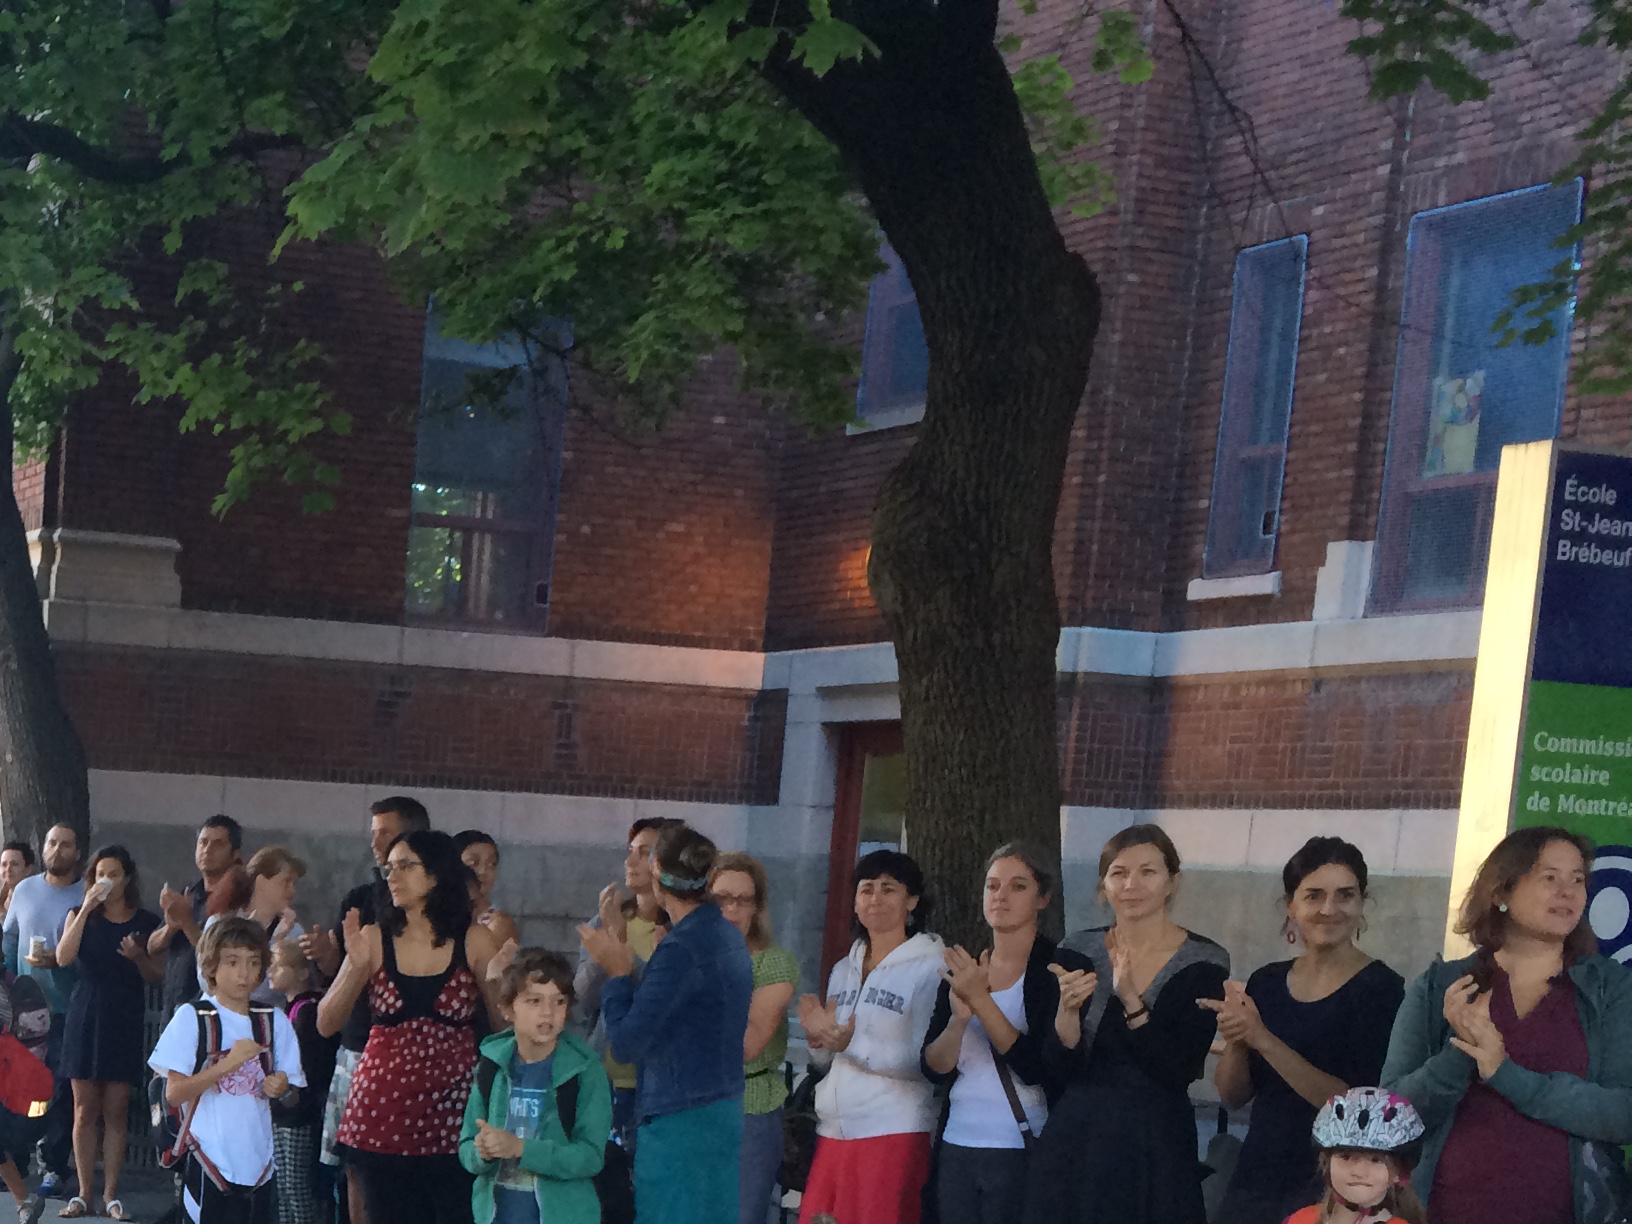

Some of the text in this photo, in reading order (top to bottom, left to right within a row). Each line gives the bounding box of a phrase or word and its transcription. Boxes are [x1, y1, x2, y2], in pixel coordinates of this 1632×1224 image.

[1564, 474, 1617, 506] École
[1560, 508, 1632, 537] St-Jean
[1557, 539, 1632, 567] Brébeuf
[1530, 763, 1610, 786] scolaire
[1526, 791, 1550, 812] de
